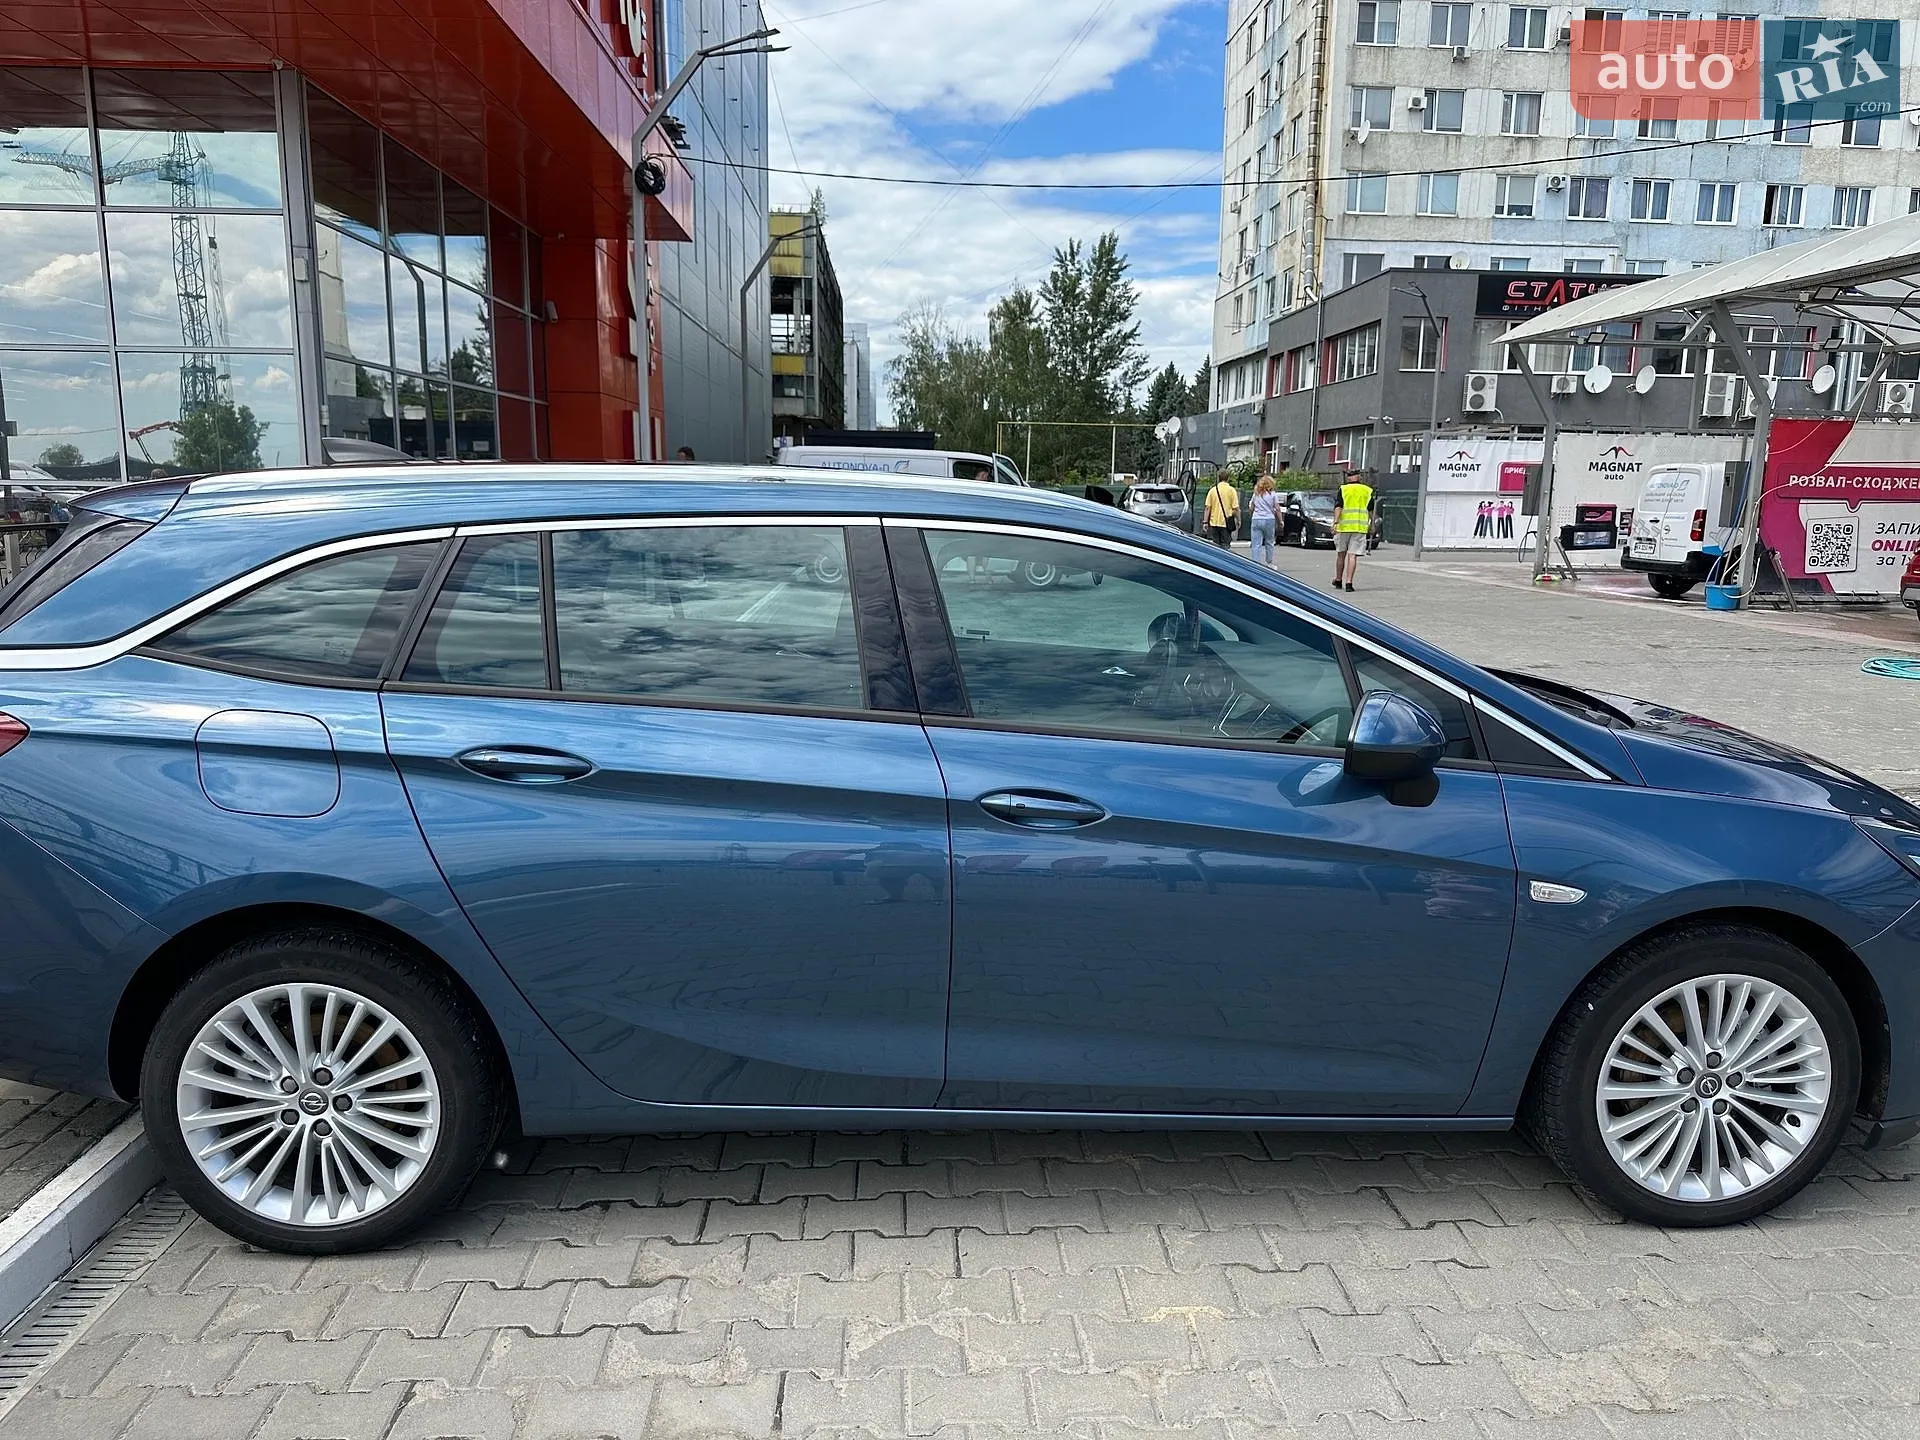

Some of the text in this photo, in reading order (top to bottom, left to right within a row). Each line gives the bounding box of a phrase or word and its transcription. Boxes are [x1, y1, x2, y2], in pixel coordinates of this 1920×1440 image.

[1504, 278, 1628, 306] СТАТ
[1438, 463, 1481, 472] MAGNAT
[1588, 461, 1643, 472] MAGNAT
[1789, 475, 1920, 491] РОЗВАЛ-СХОДЖЕ
[1876, 556, 1896, 566] за
